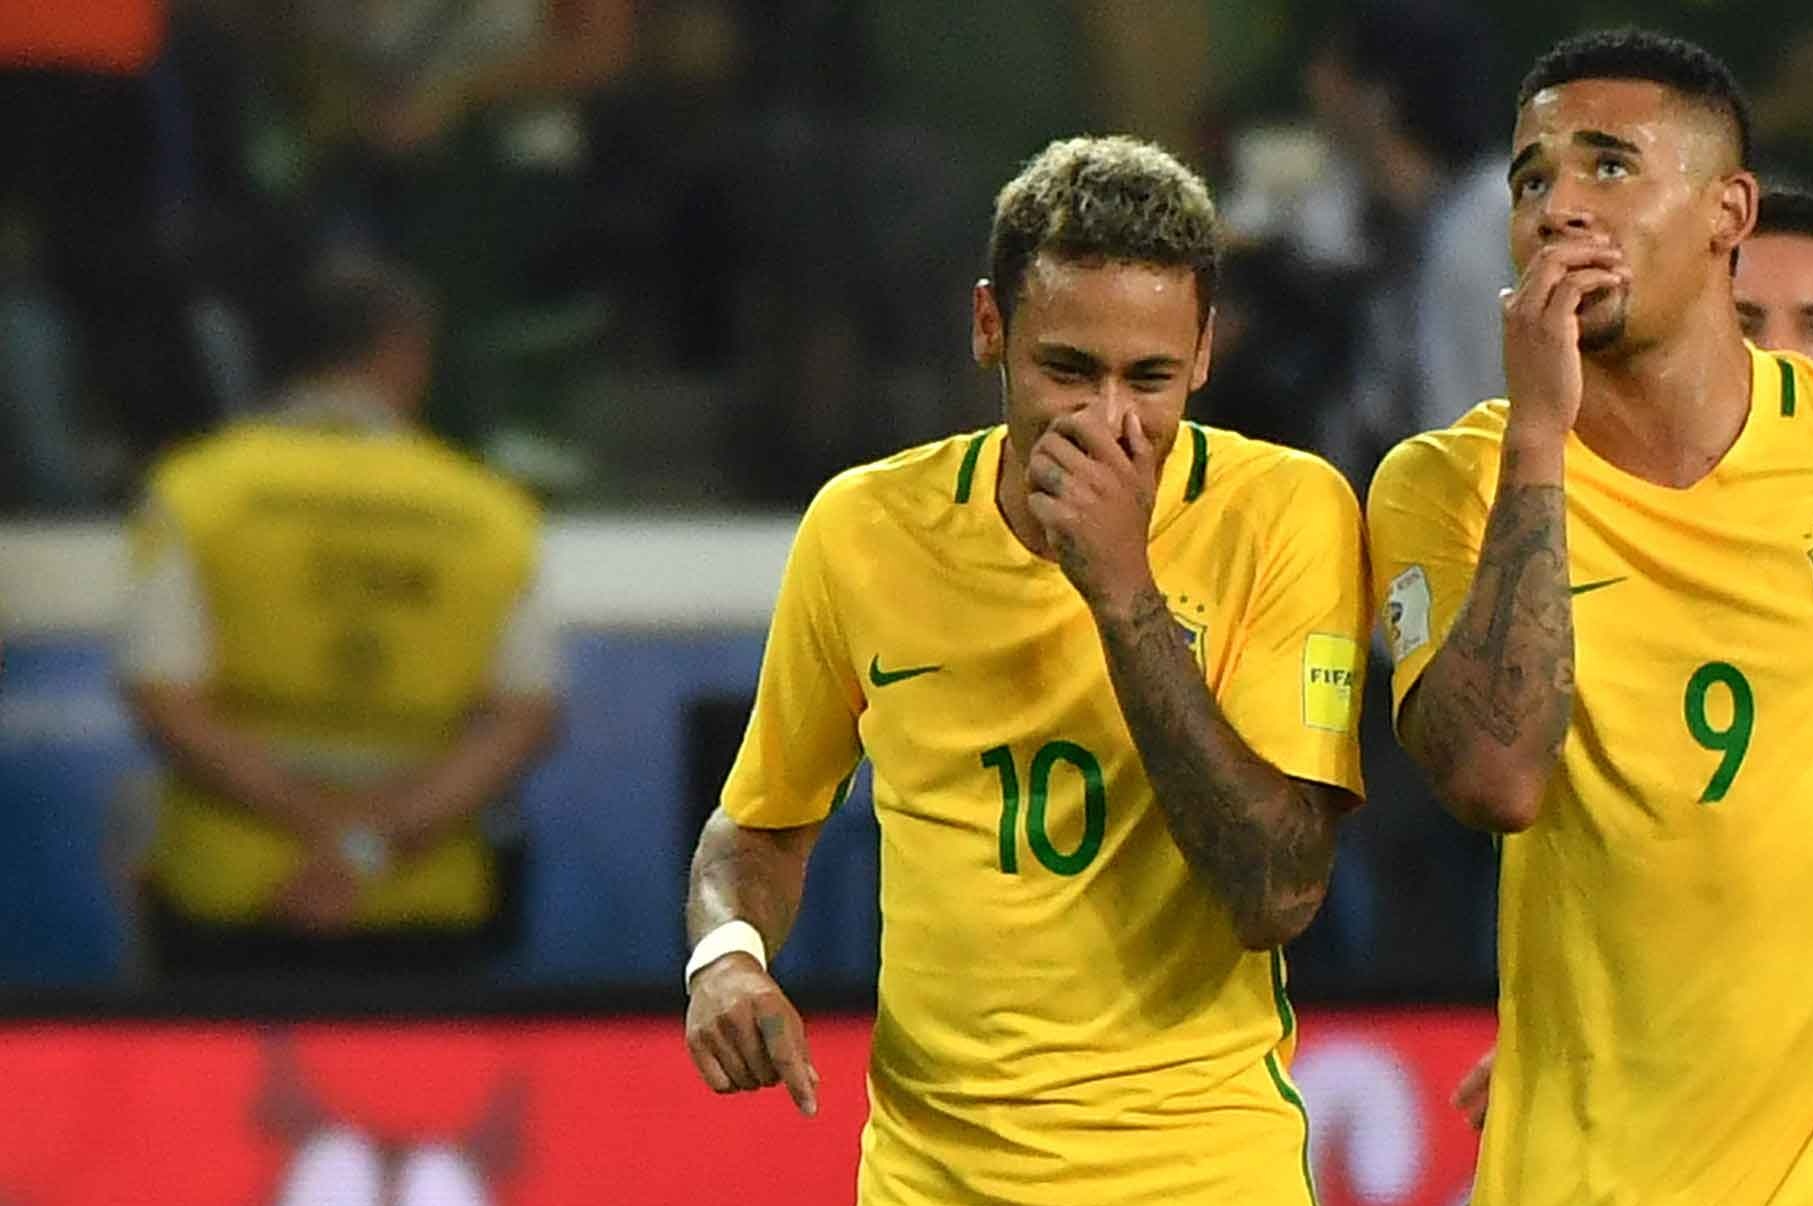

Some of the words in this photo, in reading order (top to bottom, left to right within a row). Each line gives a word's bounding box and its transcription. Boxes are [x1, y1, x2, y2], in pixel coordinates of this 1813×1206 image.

[1310, 668, 1353, 687] FIFA
[1683, 661, 1755, 804] 9
[980, 739, 1106, 877] 10
